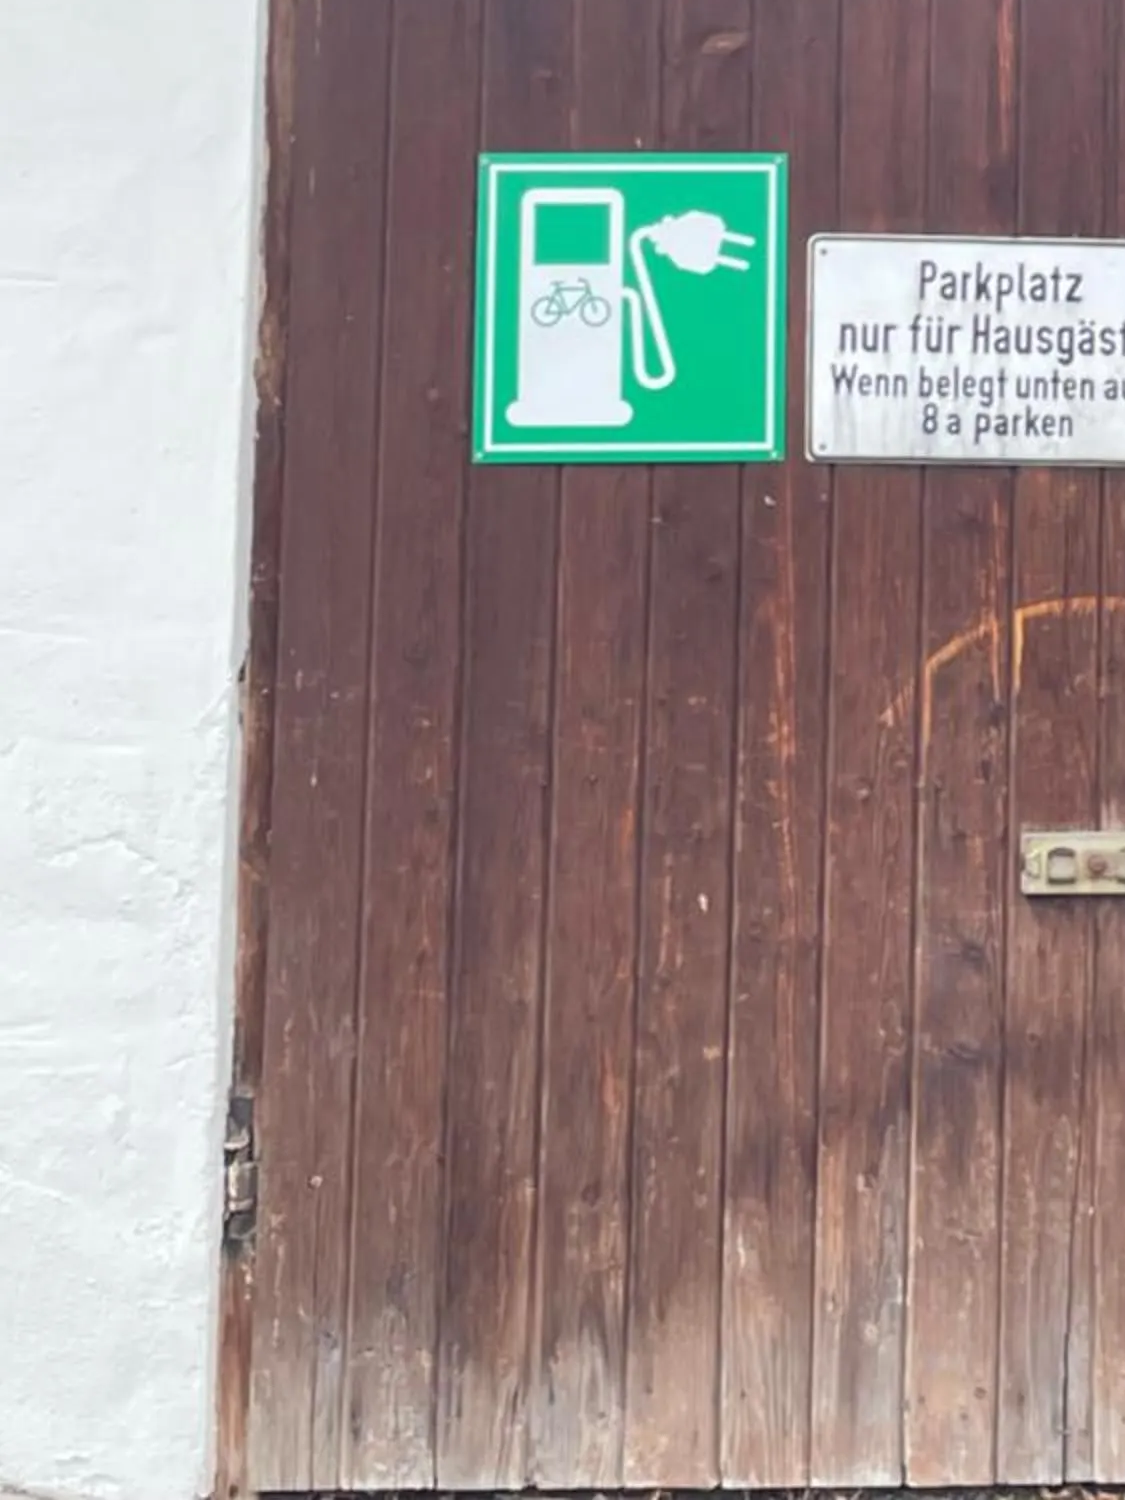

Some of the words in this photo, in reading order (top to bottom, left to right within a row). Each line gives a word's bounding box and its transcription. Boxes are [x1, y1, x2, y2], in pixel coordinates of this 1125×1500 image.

[919, 260, 1084, 312] Parkplatz
[839, 322, 897, 354] nur
[910, 314, 961, 354] für
[831, 363, 908, 398] Wenn
[918, 366, 1008, 407] belegt
[1015, 370, 1095, 401] unten
[974, 405, 1073, 444] parken
